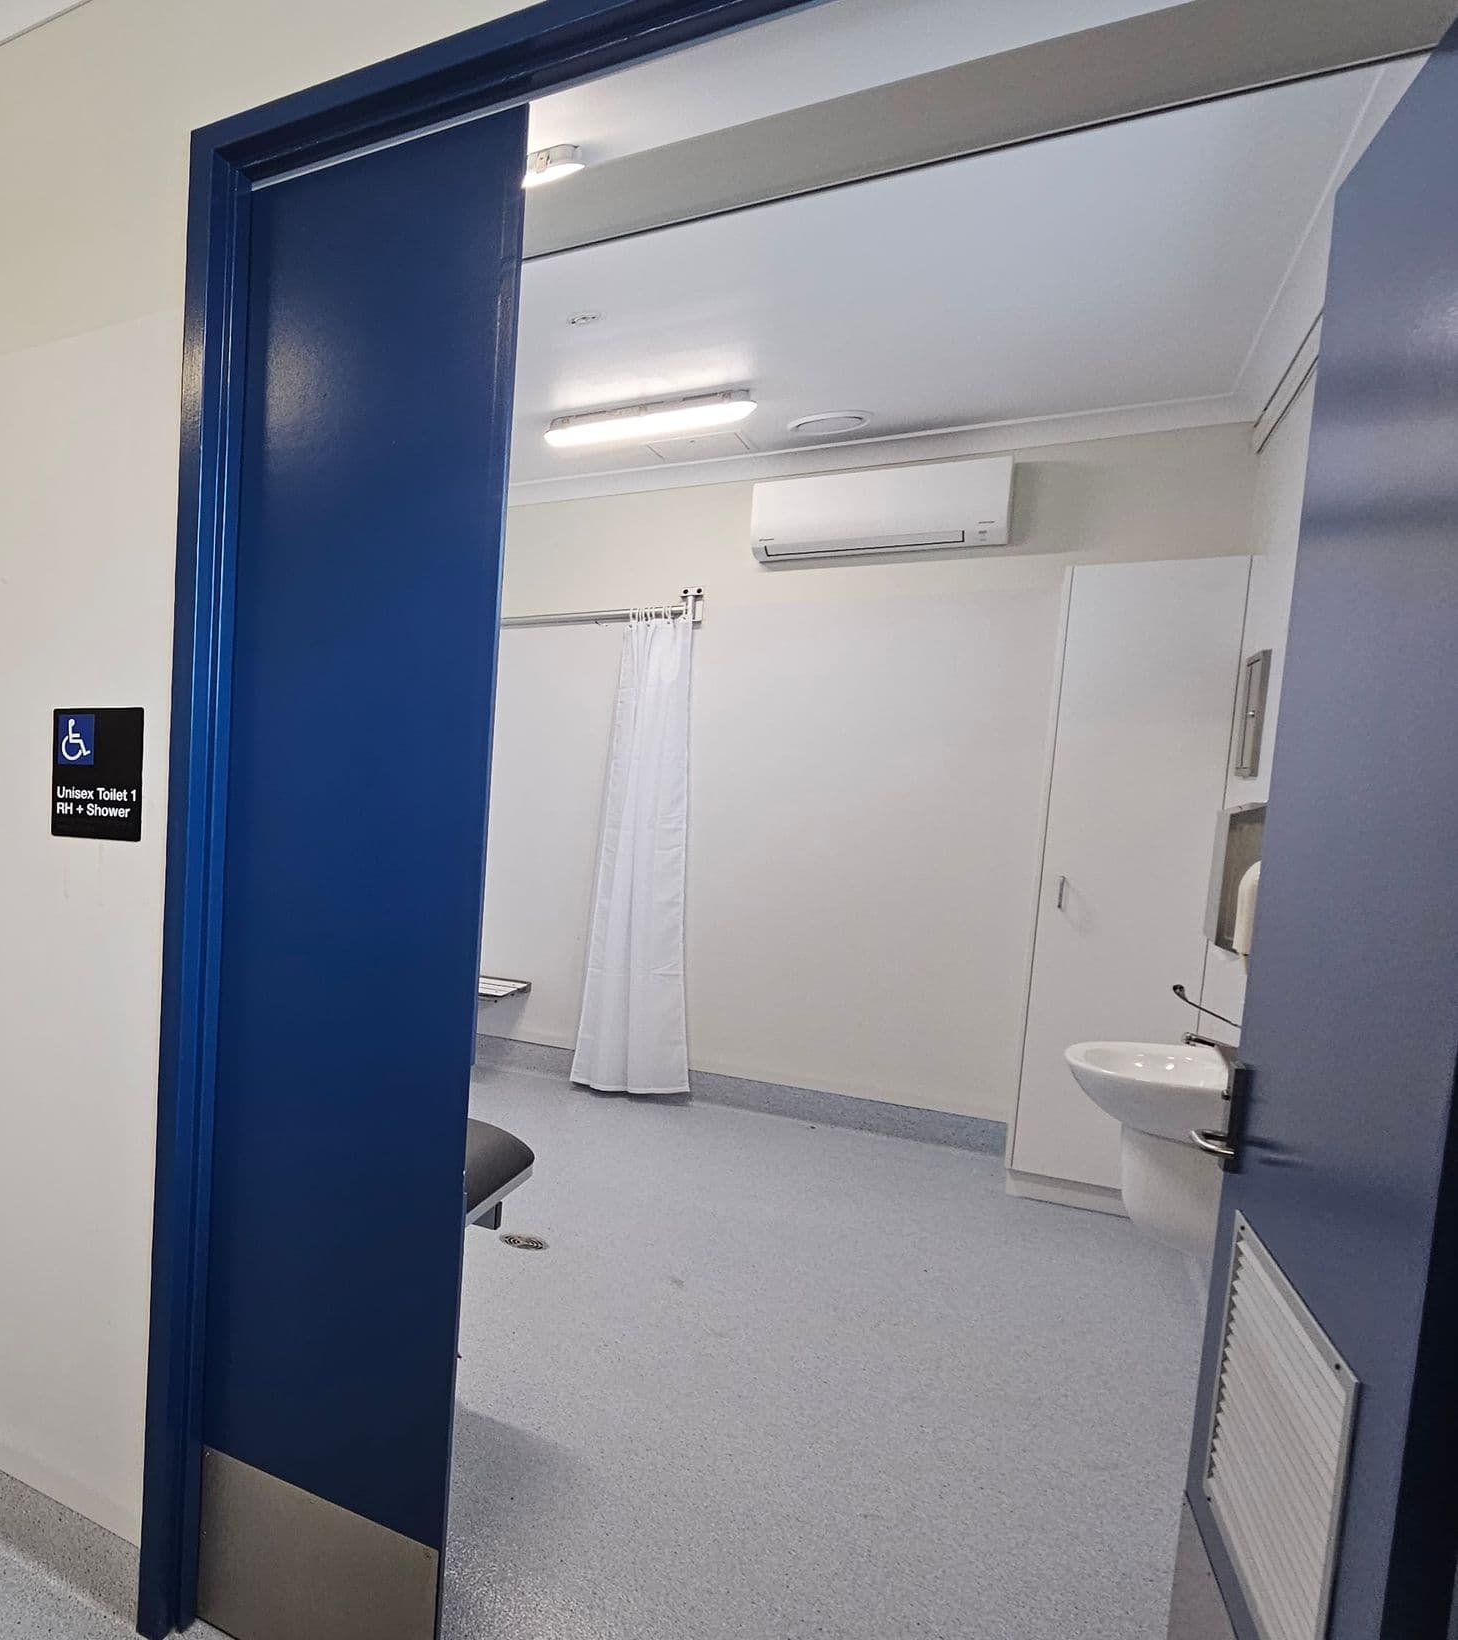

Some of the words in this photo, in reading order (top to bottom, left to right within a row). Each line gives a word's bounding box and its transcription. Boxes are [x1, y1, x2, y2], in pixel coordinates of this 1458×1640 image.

[56, 786, 94, 800] Unisex
[96, 787, 128, 801] Toilet
[131, 789, 137, 802] 1
[56, 802, 73, 815] RH
[76, 804, 84, 814] +
[86, 803, 131, 818] Shower
